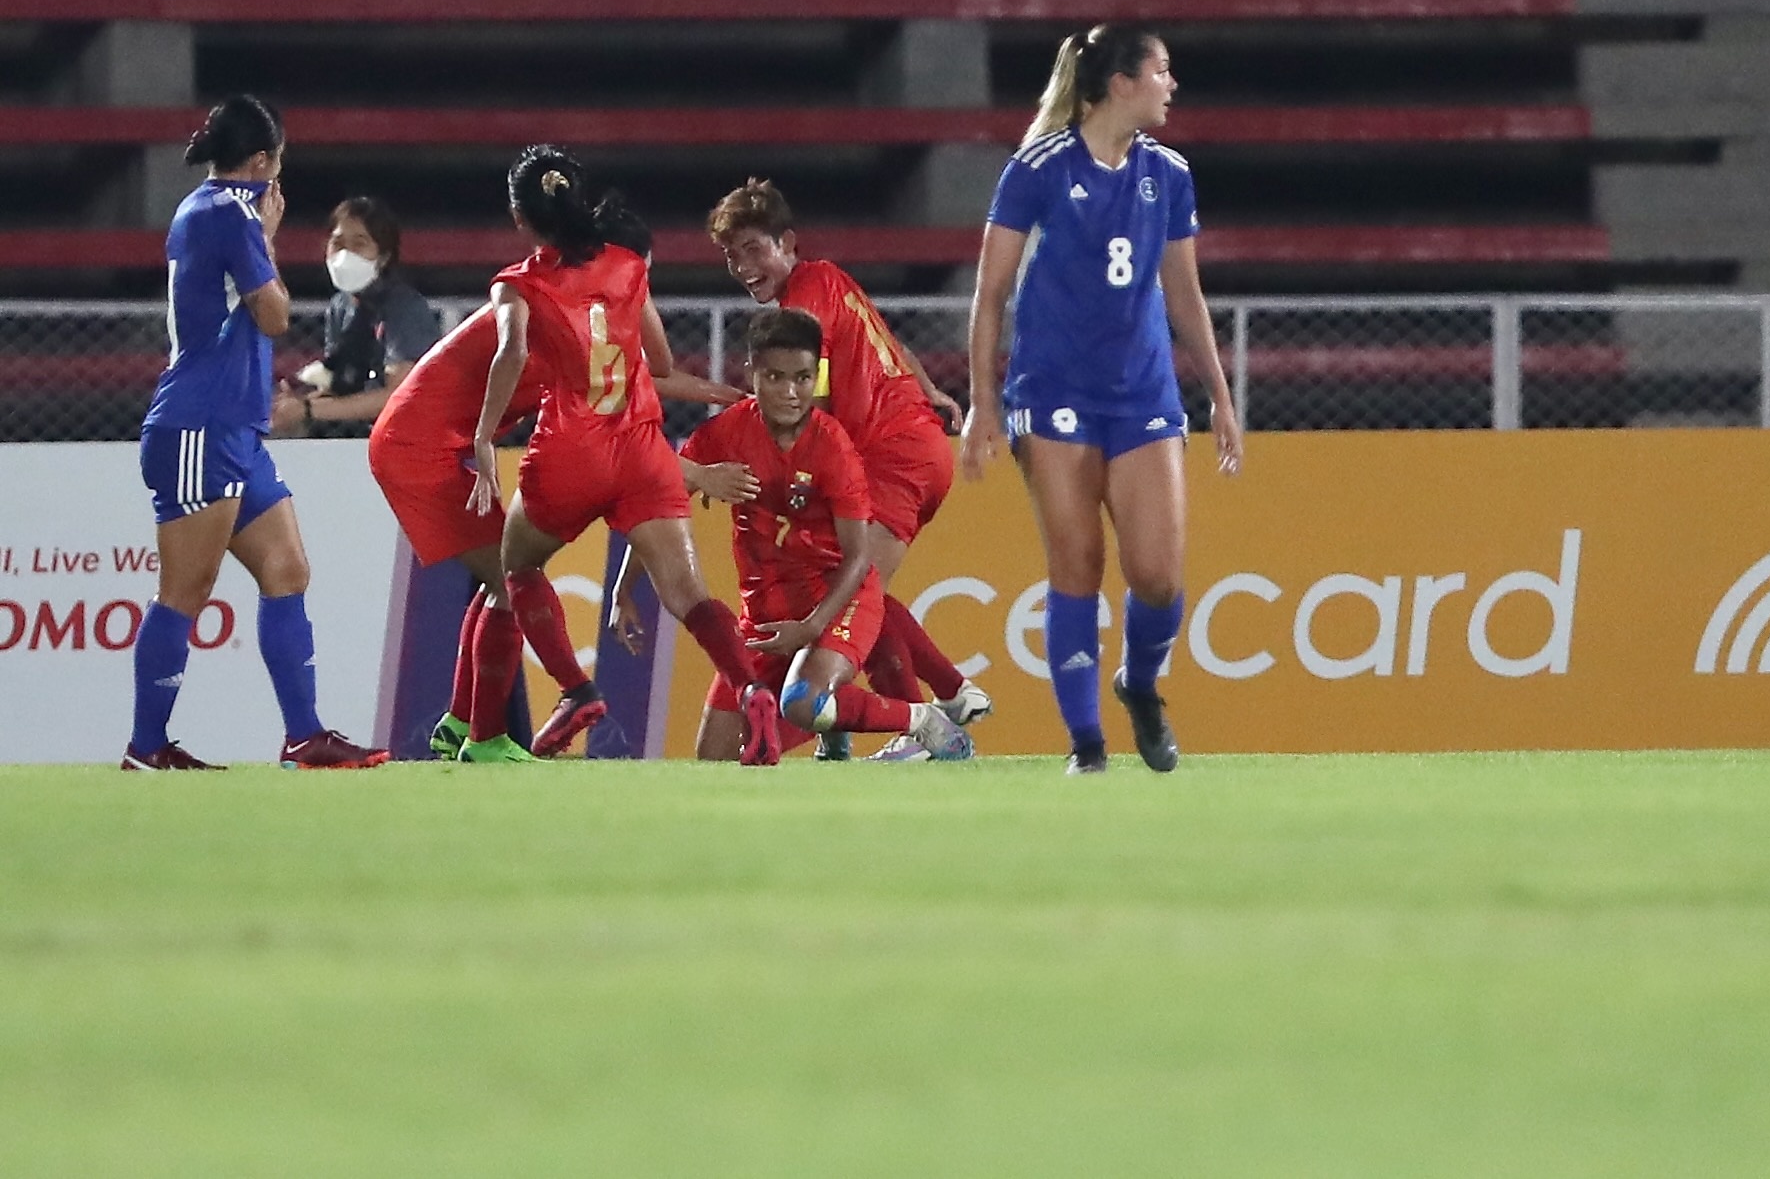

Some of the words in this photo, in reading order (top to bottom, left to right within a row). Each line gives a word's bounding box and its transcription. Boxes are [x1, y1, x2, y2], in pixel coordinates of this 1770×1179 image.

[1108, 237, 1133, 286] 8
[587, 302, 627, 415] 6
[776, 515, 791, 547] 7
[32, 546, 99, 572] Live
[112, 544, 159, 572] We
[0, 598, 236, 650] OMOO
[910, 528, 1582, 681] cecard
